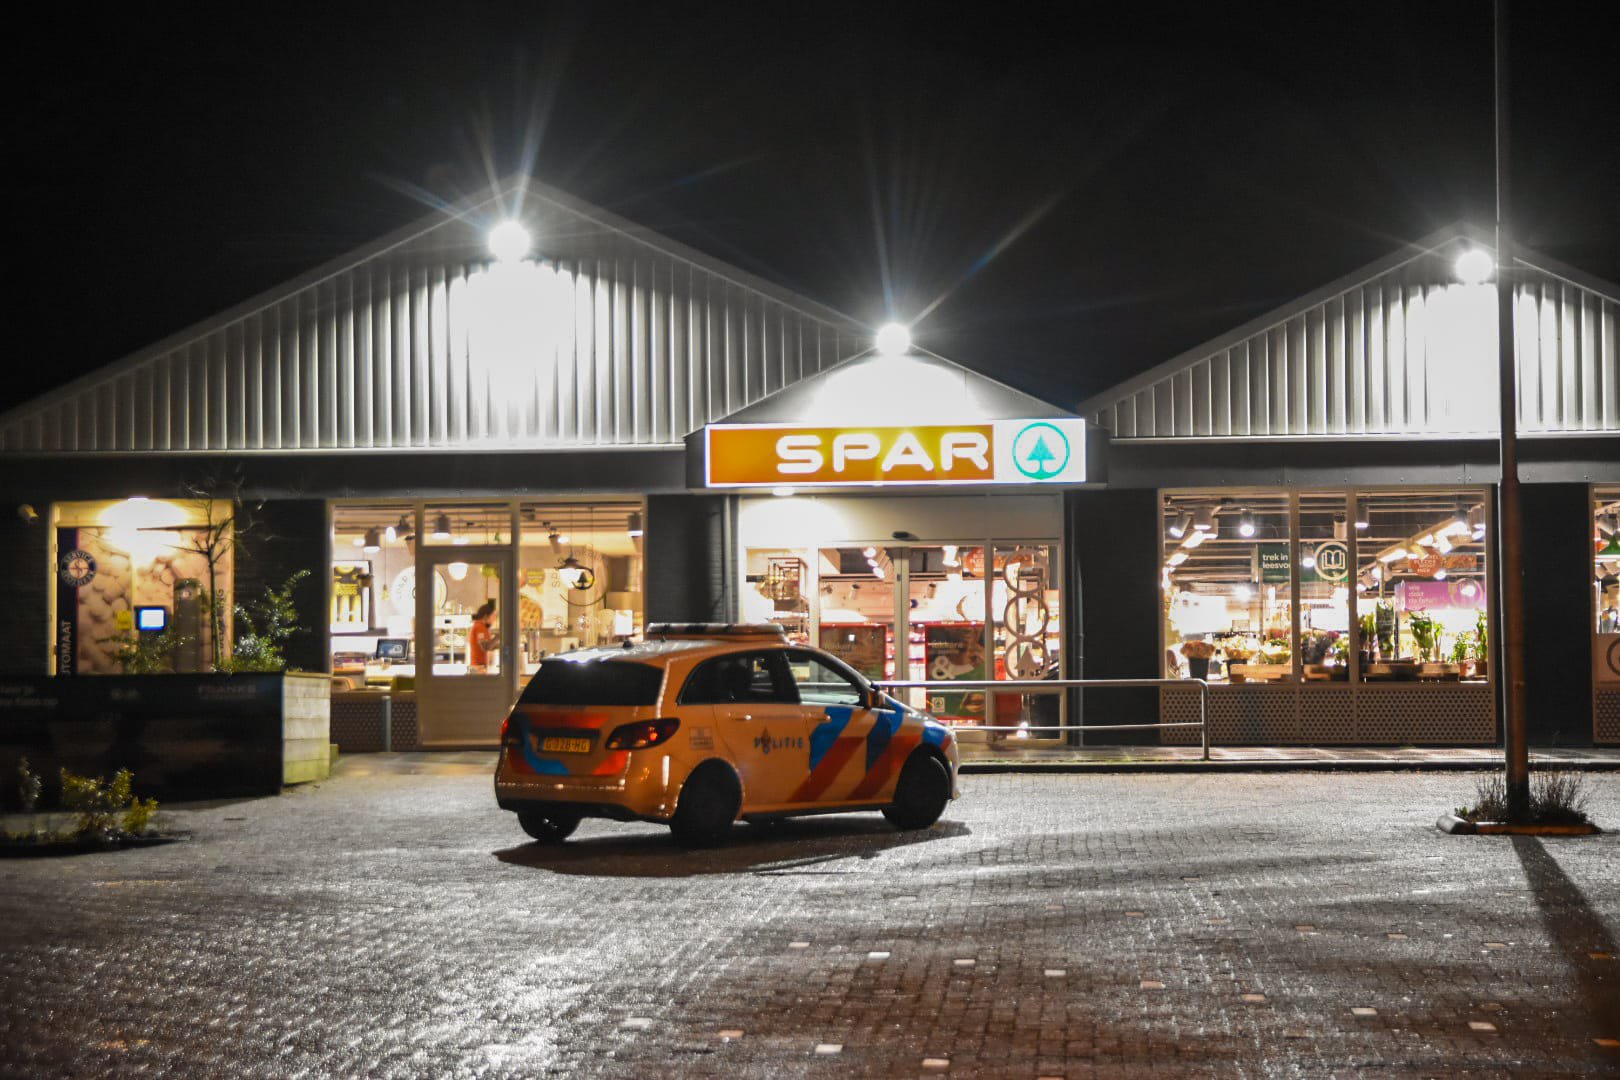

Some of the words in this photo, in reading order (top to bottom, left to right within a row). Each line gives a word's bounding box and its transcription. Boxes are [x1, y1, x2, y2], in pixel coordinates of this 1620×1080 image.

[775, 431, 989, 474] SPAR
[1262, 553, 1279, 561] trek
[1280, 553, 1288, 561] in
[1262, 561, 1290, 569] leesvo
